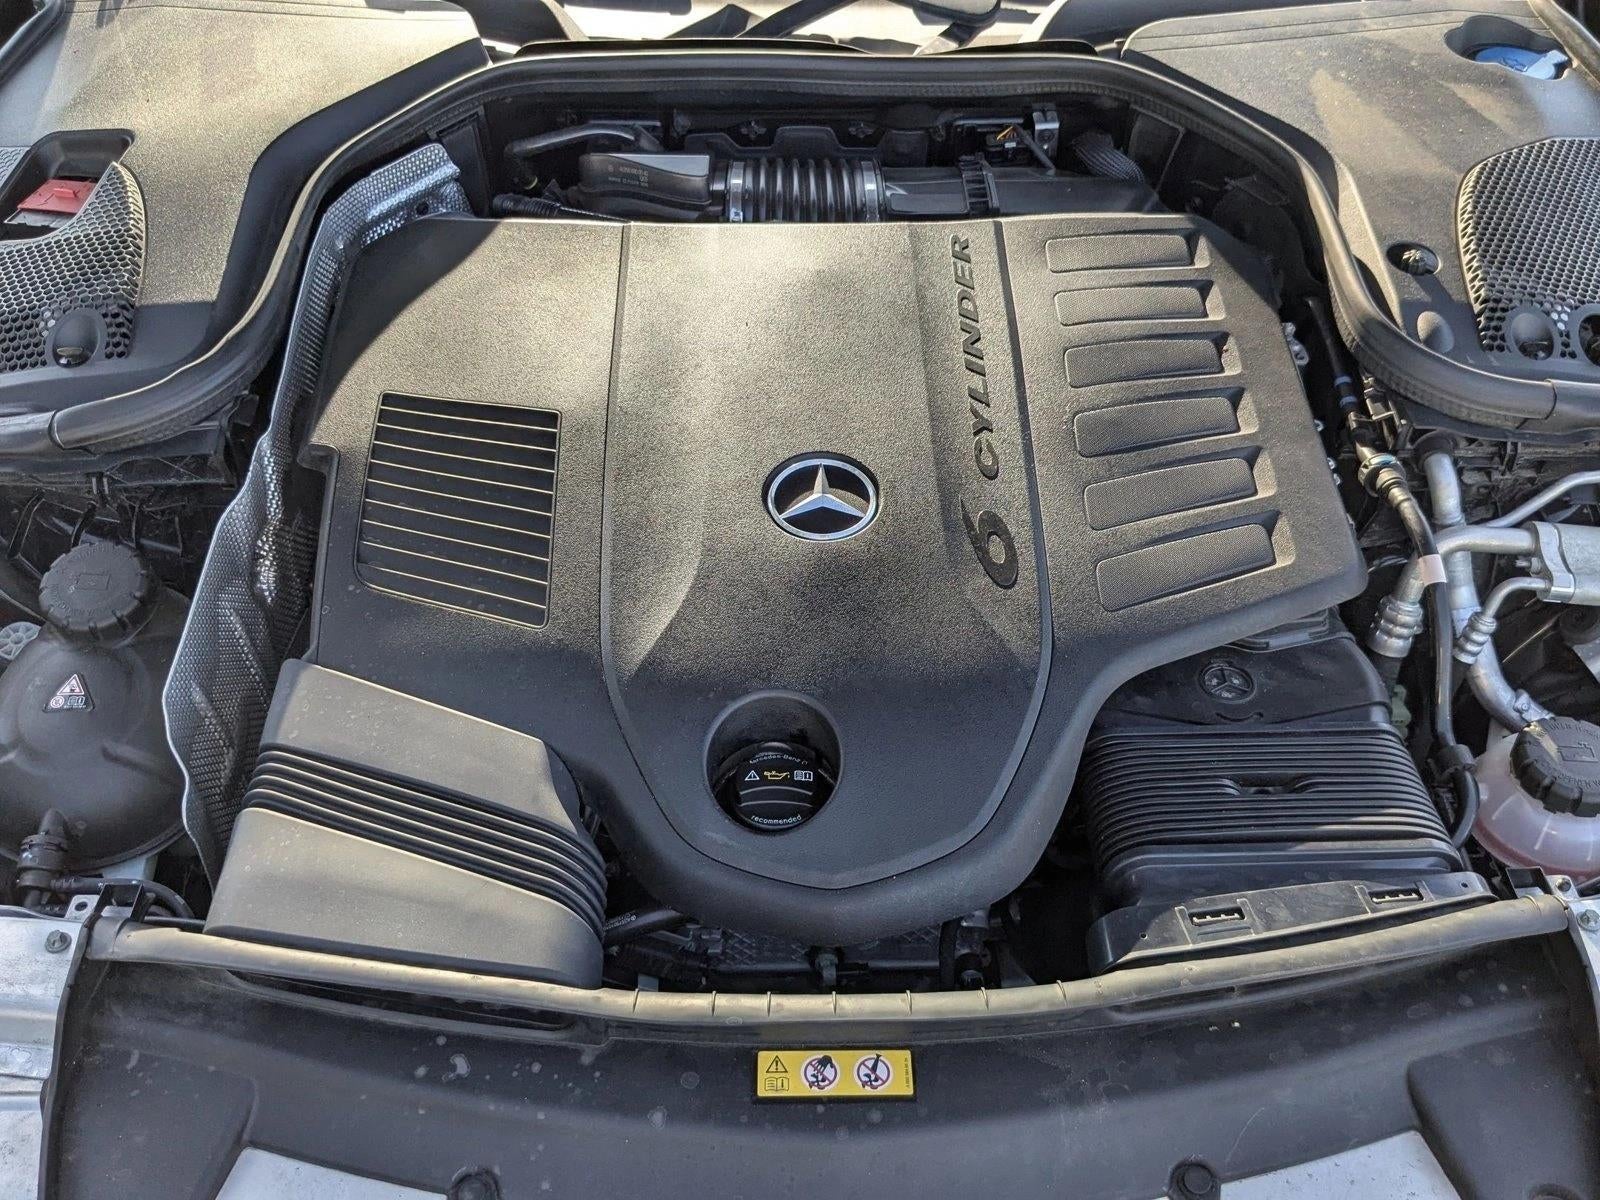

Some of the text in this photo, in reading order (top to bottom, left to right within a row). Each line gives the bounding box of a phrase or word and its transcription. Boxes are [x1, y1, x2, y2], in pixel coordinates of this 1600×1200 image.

[950, 234, 1018, 589] 6 CYLINDER
[751, 814, 802, 824] recommended
